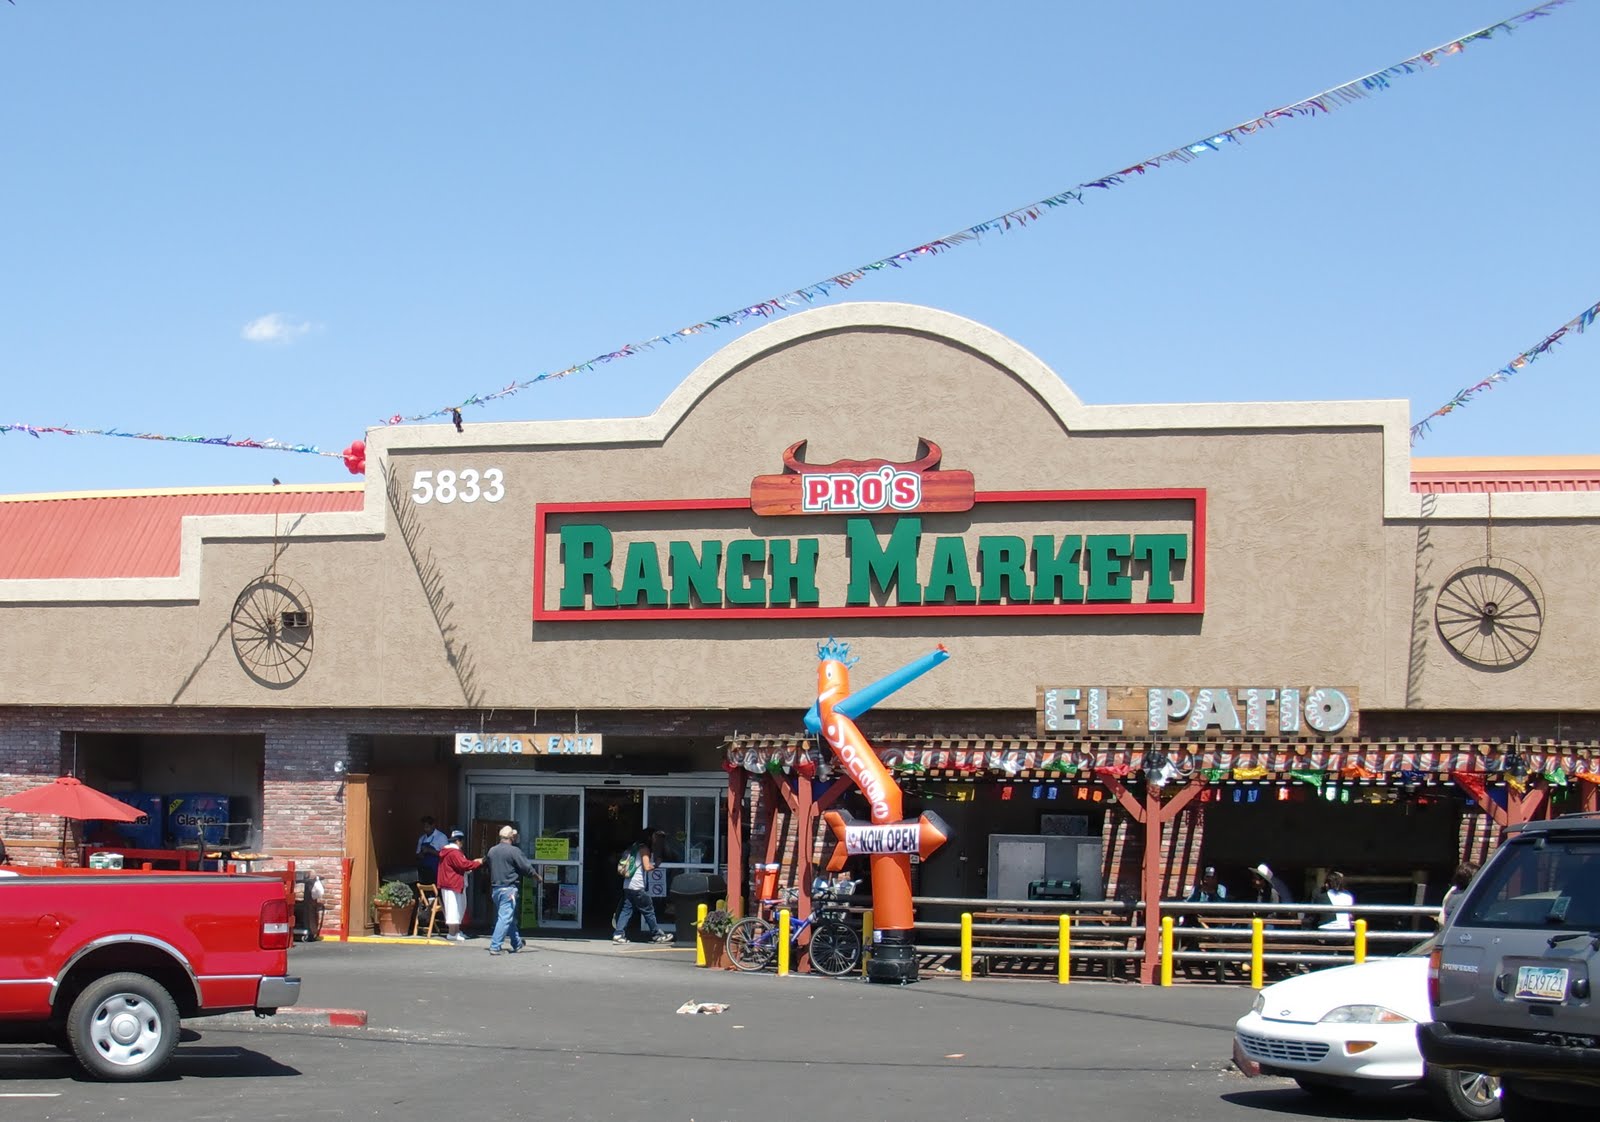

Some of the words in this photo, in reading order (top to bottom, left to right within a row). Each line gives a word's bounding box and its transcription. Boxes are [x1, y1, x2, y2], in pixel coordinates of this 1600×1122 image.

[412, 467, 505, 505] 5833
[805, 469, 919, 509] PRO'S
[560, 524, 819, 608] RANCH
[846, 517, 1188, 605] MARKET
[1045, 688, 1124, 734] EL
[1149, 687, 1350, 735] PATIO
[460, 735, 523, 755] Salida
[547, 735, 594, 755] Exit
[860, 829, 884, 852] NOW
[886, 828, 917, 851] OPEN
[1523, 974, 1563, 992] AEX9721
